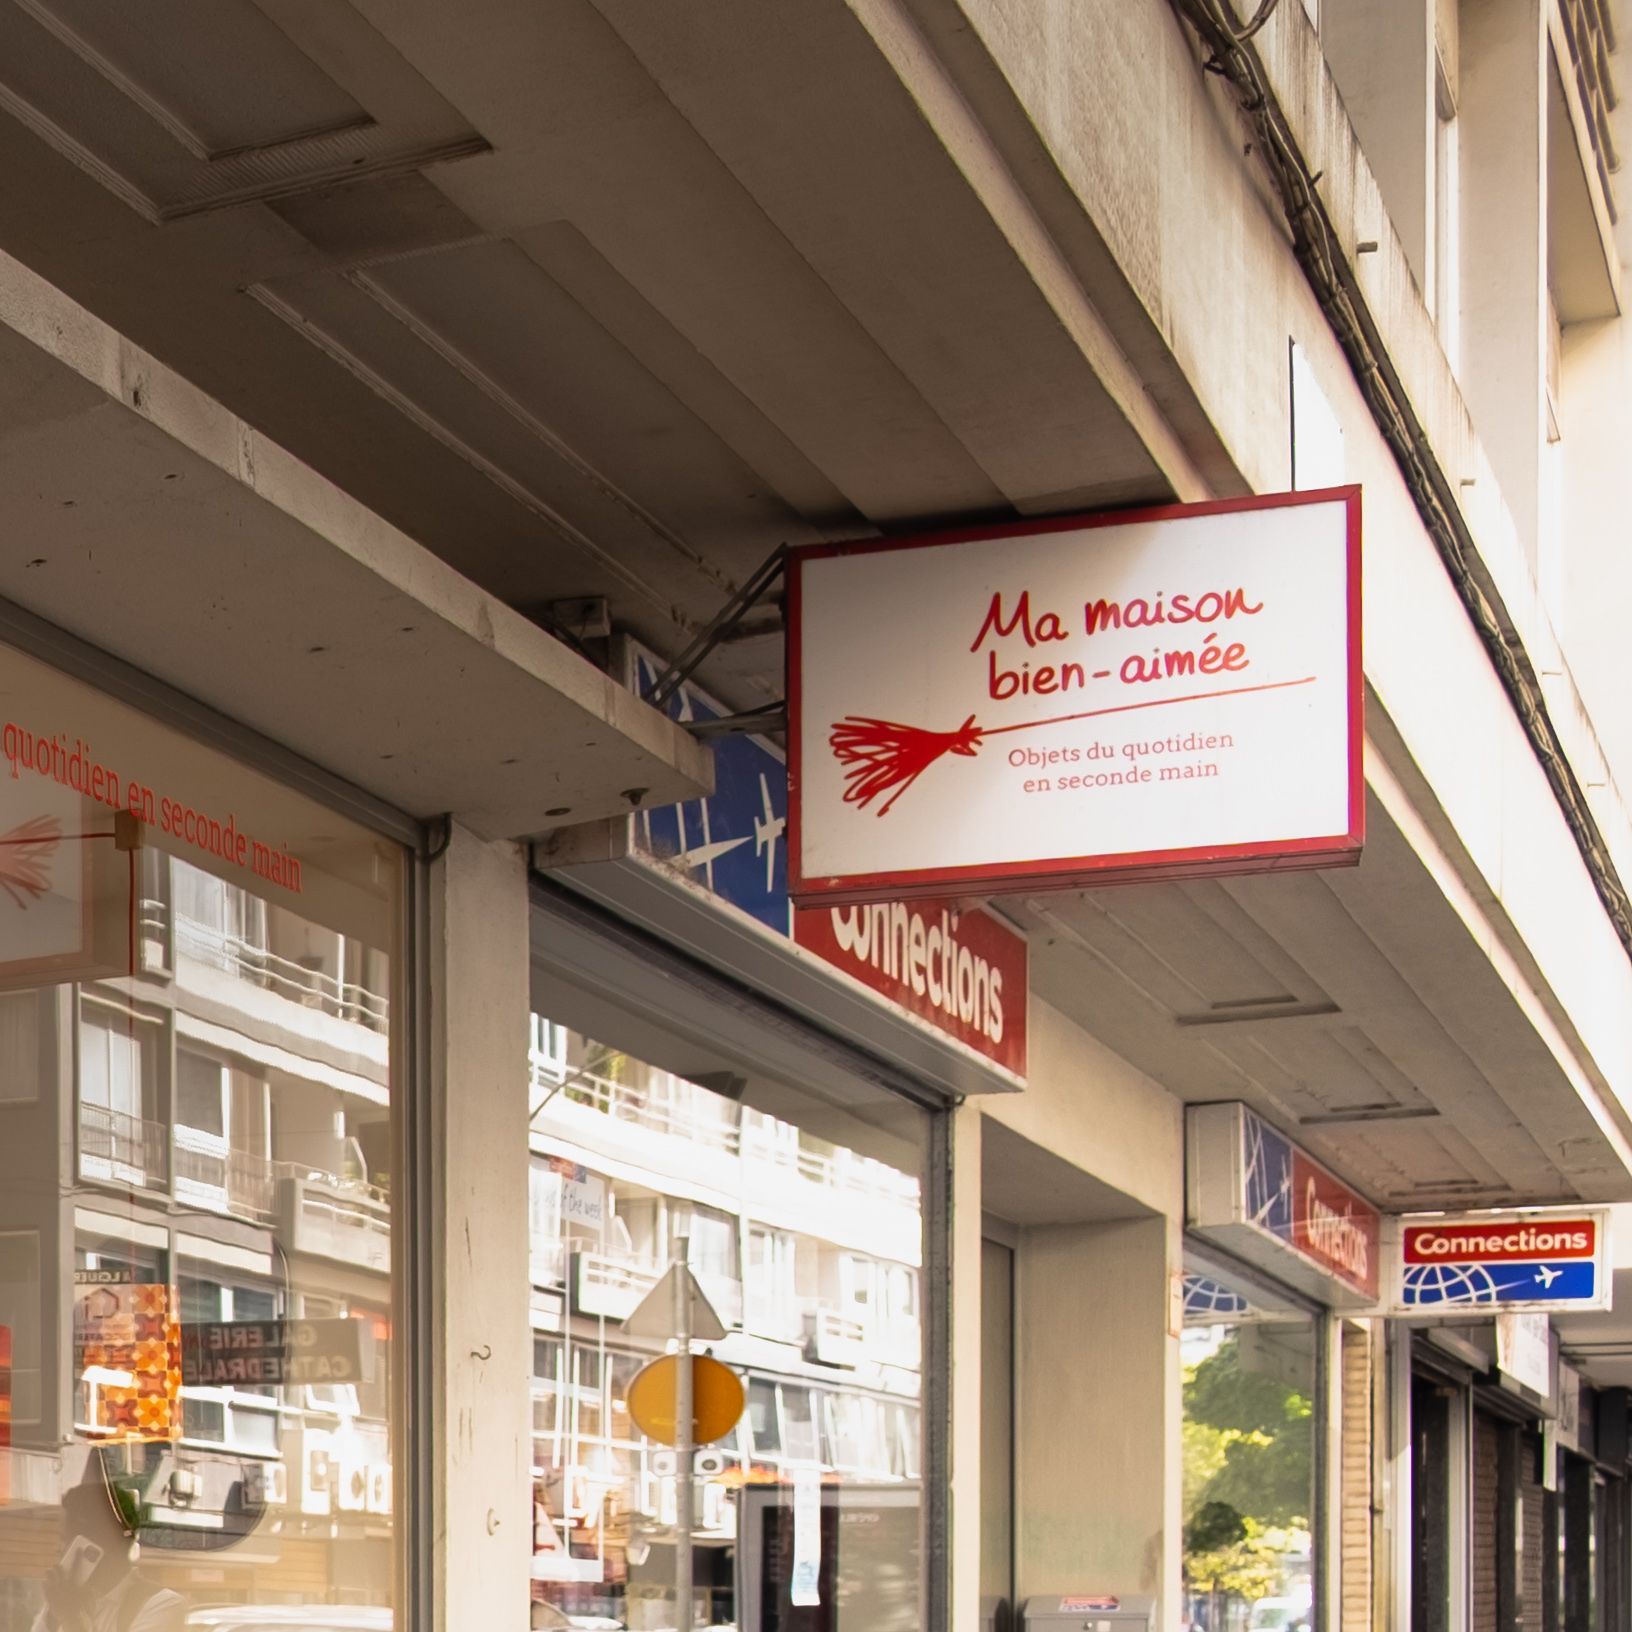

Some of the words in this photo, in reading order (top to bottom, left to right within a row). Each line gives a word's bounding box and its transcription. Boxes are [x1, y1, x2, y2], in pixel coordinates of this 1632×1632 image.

[970, 589, 1069, 653] Ma
[1084, 585, 1264, 637] maison
[988, 631, 1251, 700] bien-aimée
[1008, 746, 1080, 769] Objets
[1086, 742, 1116, 761] du
[1122, 730, 1235, 764] quotidien
[1023, 777, 1052, 794] en
[1057, 767, 1153, 791] seconde
[1159, 759, 1219, 783] main
[3, 722, 121, 809] quotidien
[128, 780, 156, 825] en
[161, 796, 248, 867] seconde
[252, 840, 302, 894] main
[1306, 1175, 1367, 1280] Connections
[1414, 1227, 1588, 1256] Connections
